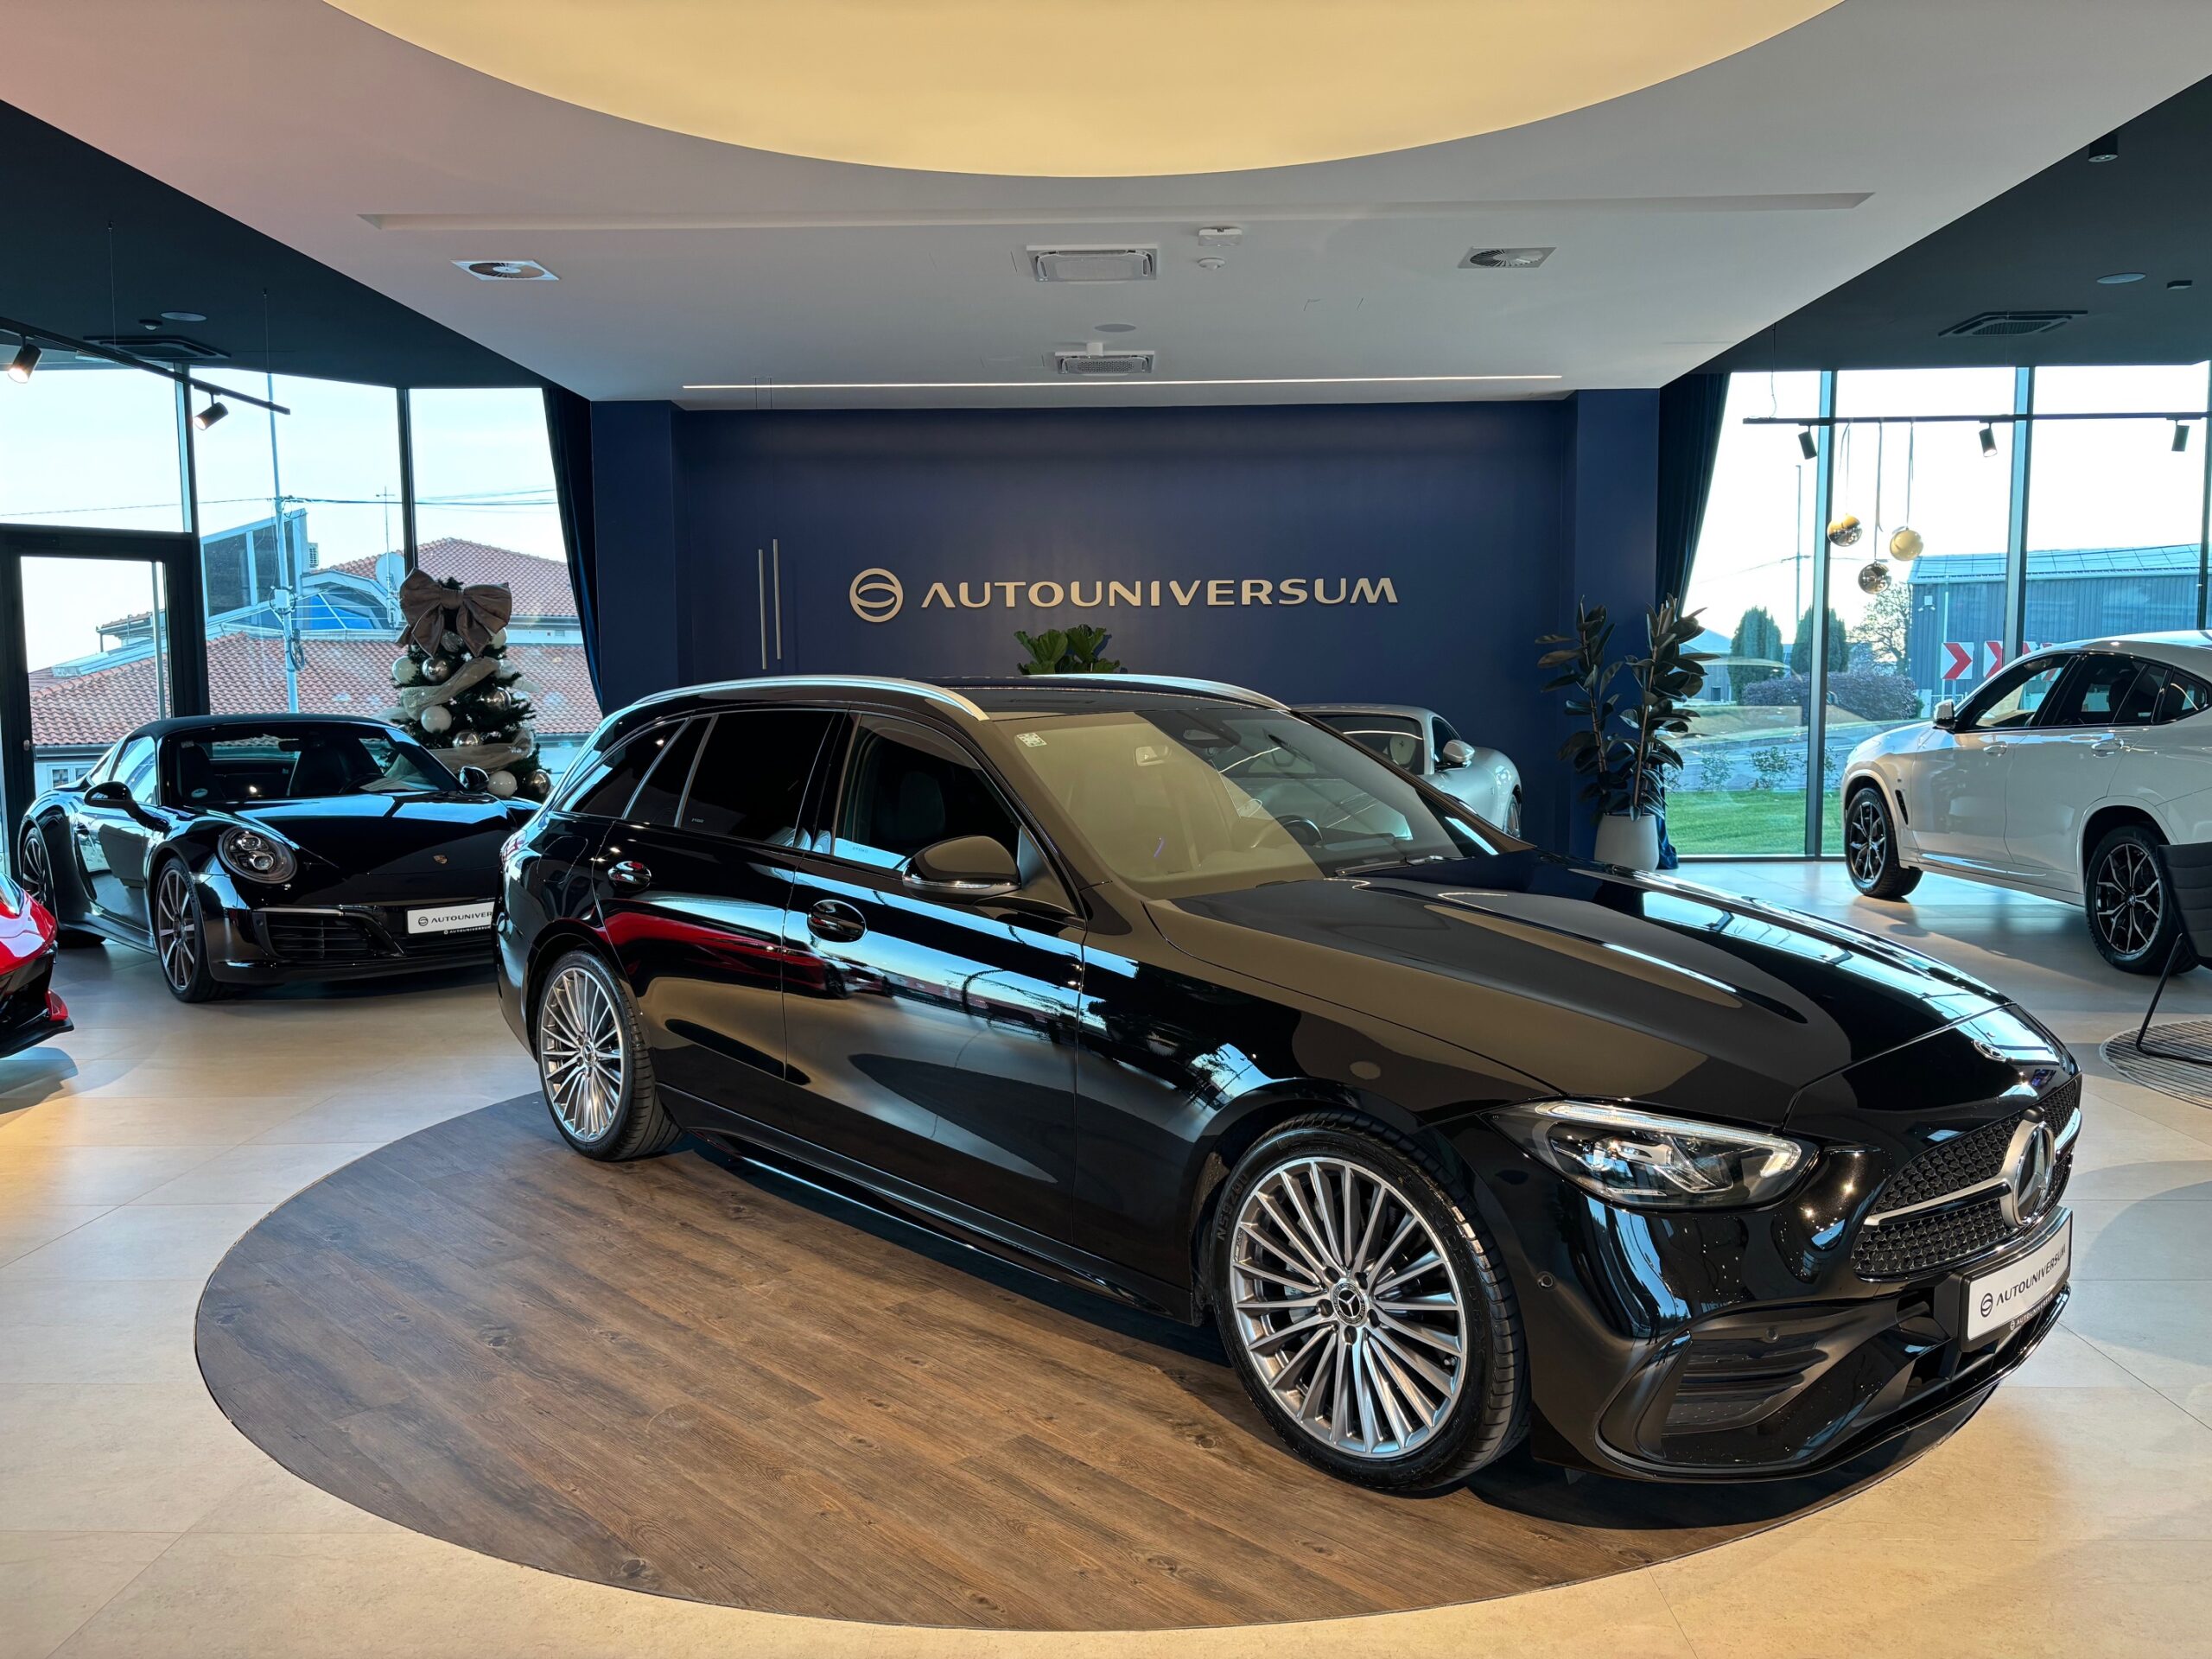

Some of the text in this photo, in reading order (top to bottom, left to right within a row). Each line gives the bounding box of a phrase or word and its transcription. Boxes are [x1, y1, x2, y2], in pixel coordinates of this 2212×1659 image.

[920, 576, 1399, 608] AUTOUNIVERSUM
[431, 911, 493, 924] AUTOUNIVER
[1996, 1243, 2066, 1306] AUTOUNIVERSUM
